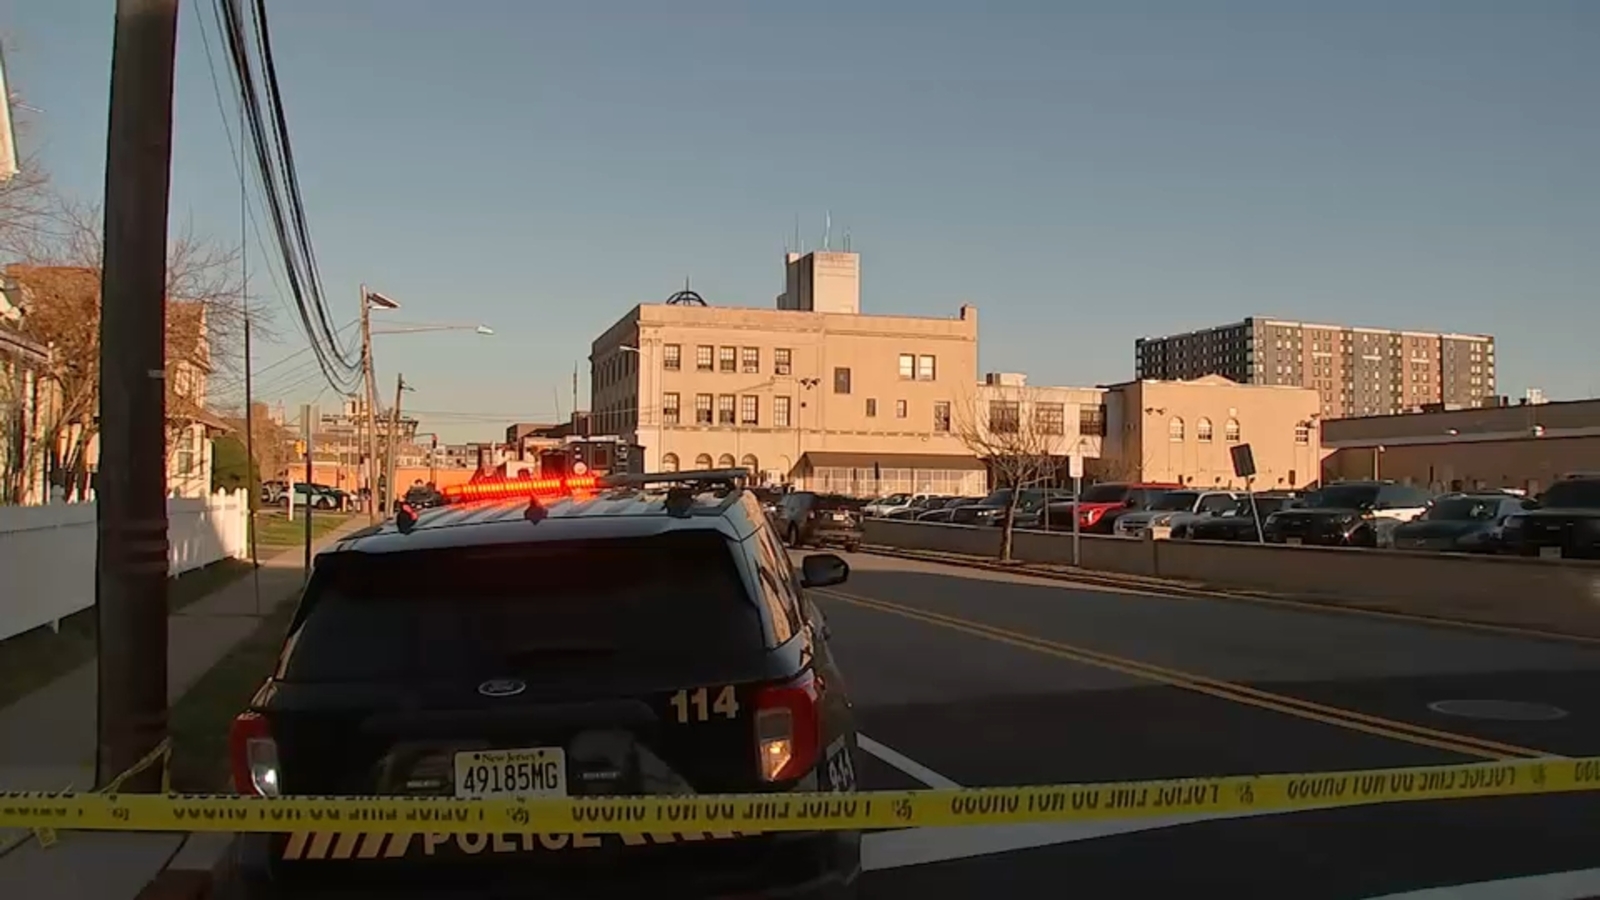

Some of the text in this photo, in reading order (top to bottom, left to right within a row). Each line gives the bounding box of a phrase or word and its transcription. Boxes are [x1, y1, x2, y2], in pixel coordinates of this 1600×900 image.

[670, 685, 739, 723] 114
[481, 752, 536, 763] New Jersey
[463, 762, 557, 793] 49185MG
